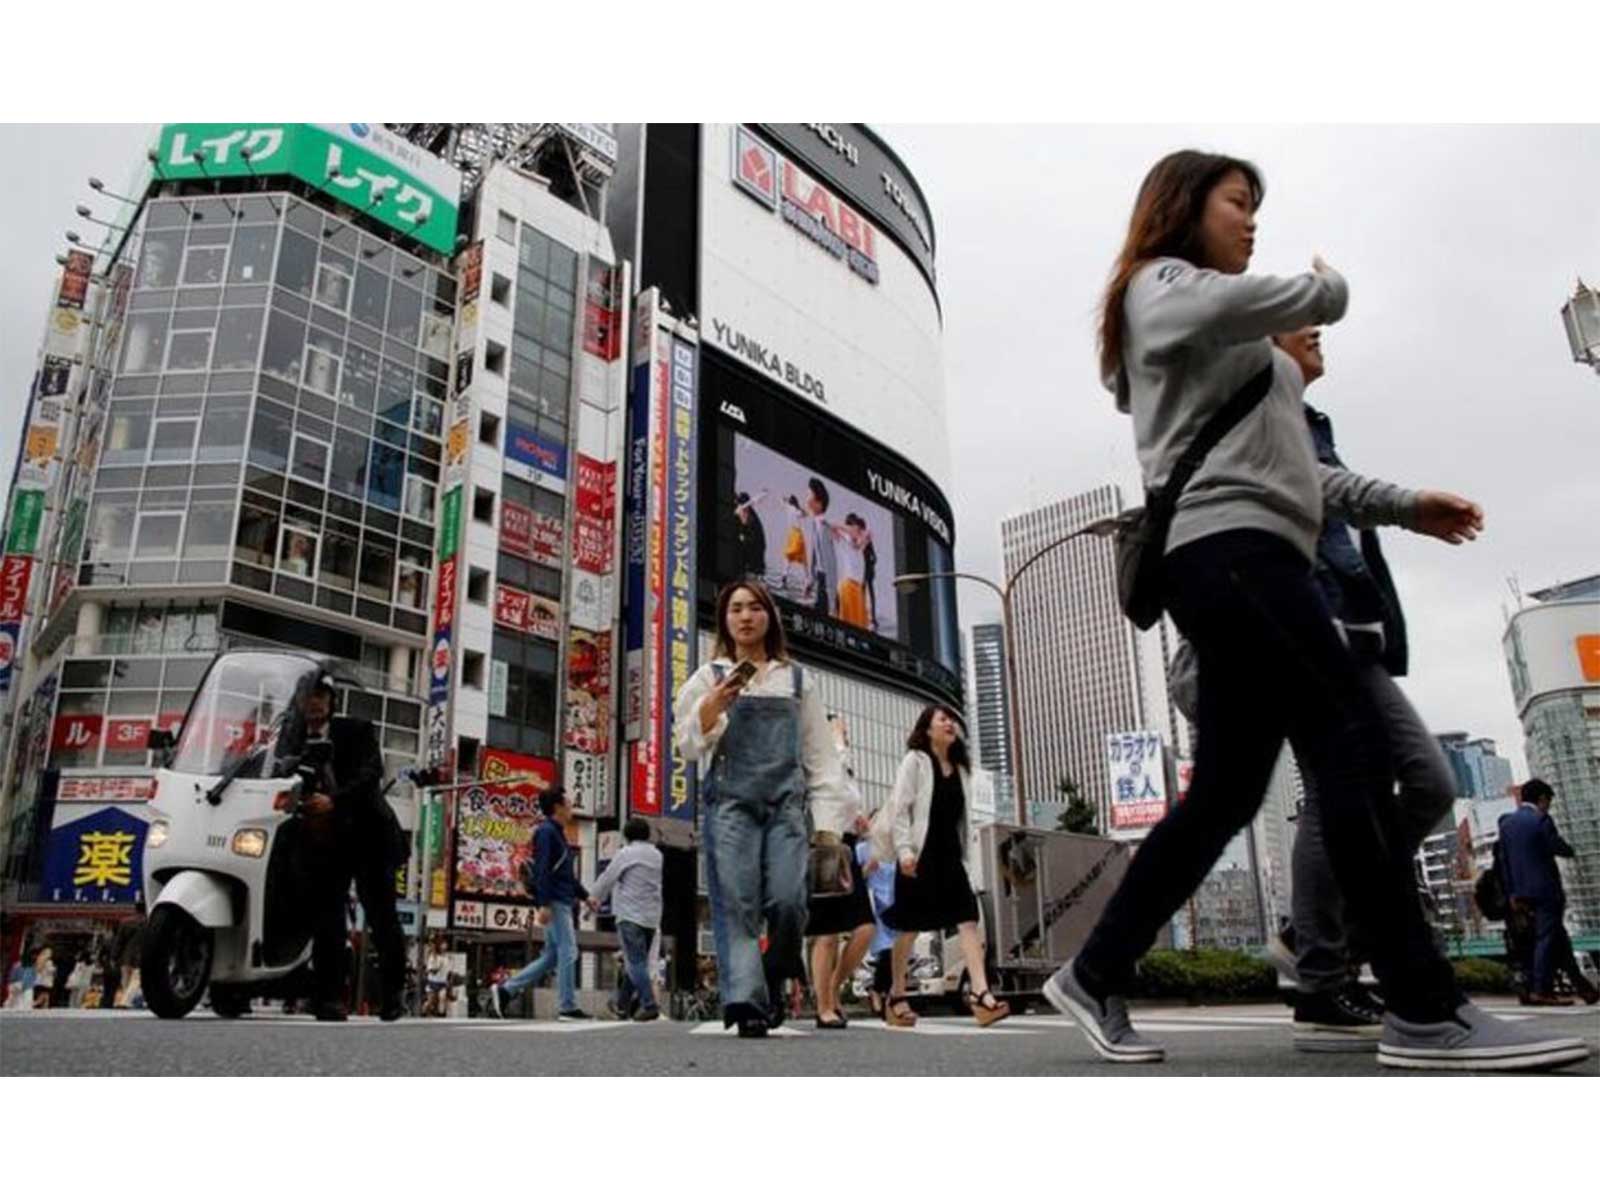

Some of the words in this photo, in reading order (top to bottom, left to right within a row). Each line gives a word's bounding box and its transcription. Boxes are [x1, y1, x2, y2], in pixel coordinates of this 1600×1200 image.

[169, 127, 284, 166] レイク
[324, 143, 434, 223] レイク
[781, 158, 877, 260] LABI
[711, 317, 783, 378] YUNIKA
[866, 468, 921, 518] YUNIKA
[65, 720, 92, 746] ル
[116, 722, 147, 743] 3F
[1110, 735, 1158, 762] カラオケ
[1116, 776, 1160, 800] 鉄人
[1129, 761, 1142, 776] の
[73, 830, 138, 888] 薬
